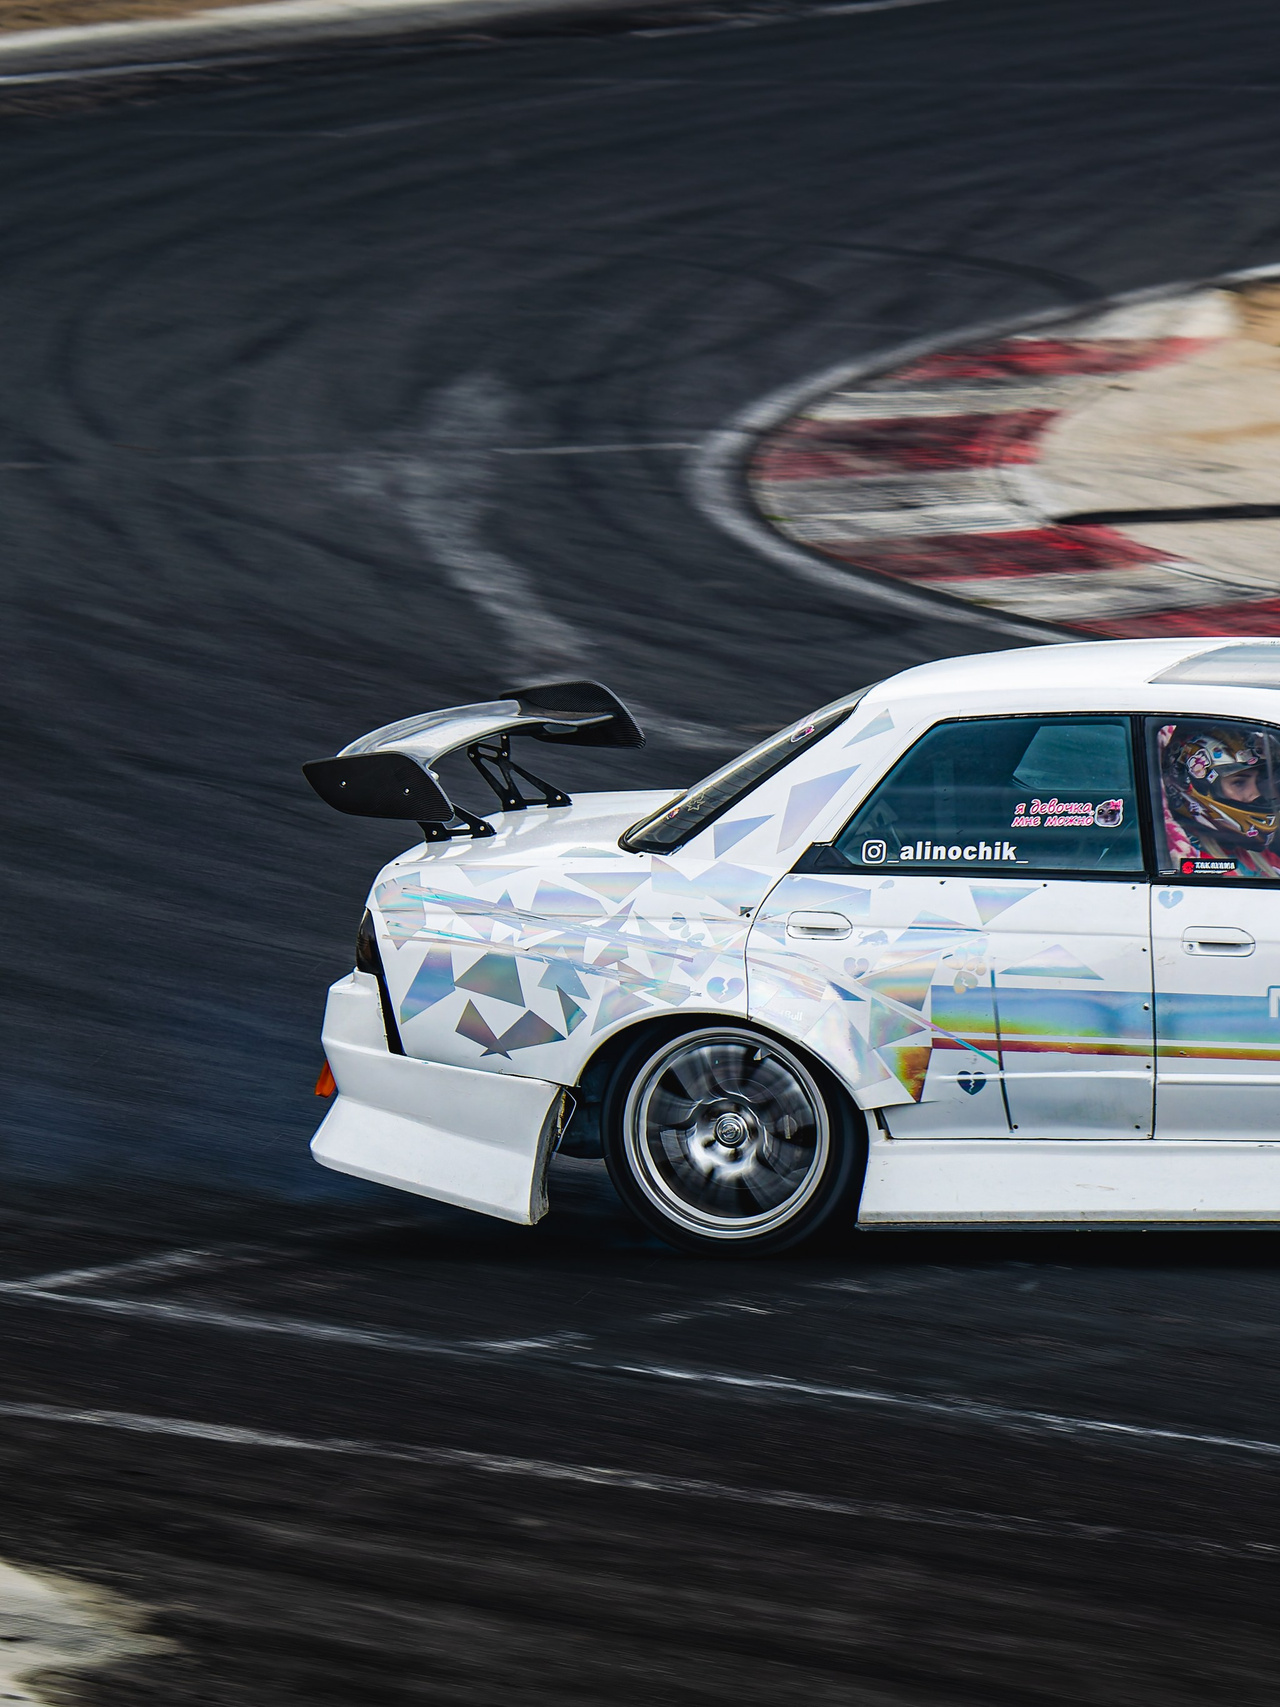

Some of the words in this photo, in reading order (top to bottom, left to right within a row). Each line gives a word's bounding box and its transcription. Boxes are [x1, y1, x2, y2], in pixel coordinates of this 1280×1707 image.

[1014, 803, 1027, 815] я
[1030, 798, 1095, 816] девочка,
[1011, 815, 1041, 827] мне
[1043, 815, 1094, 827] можно
